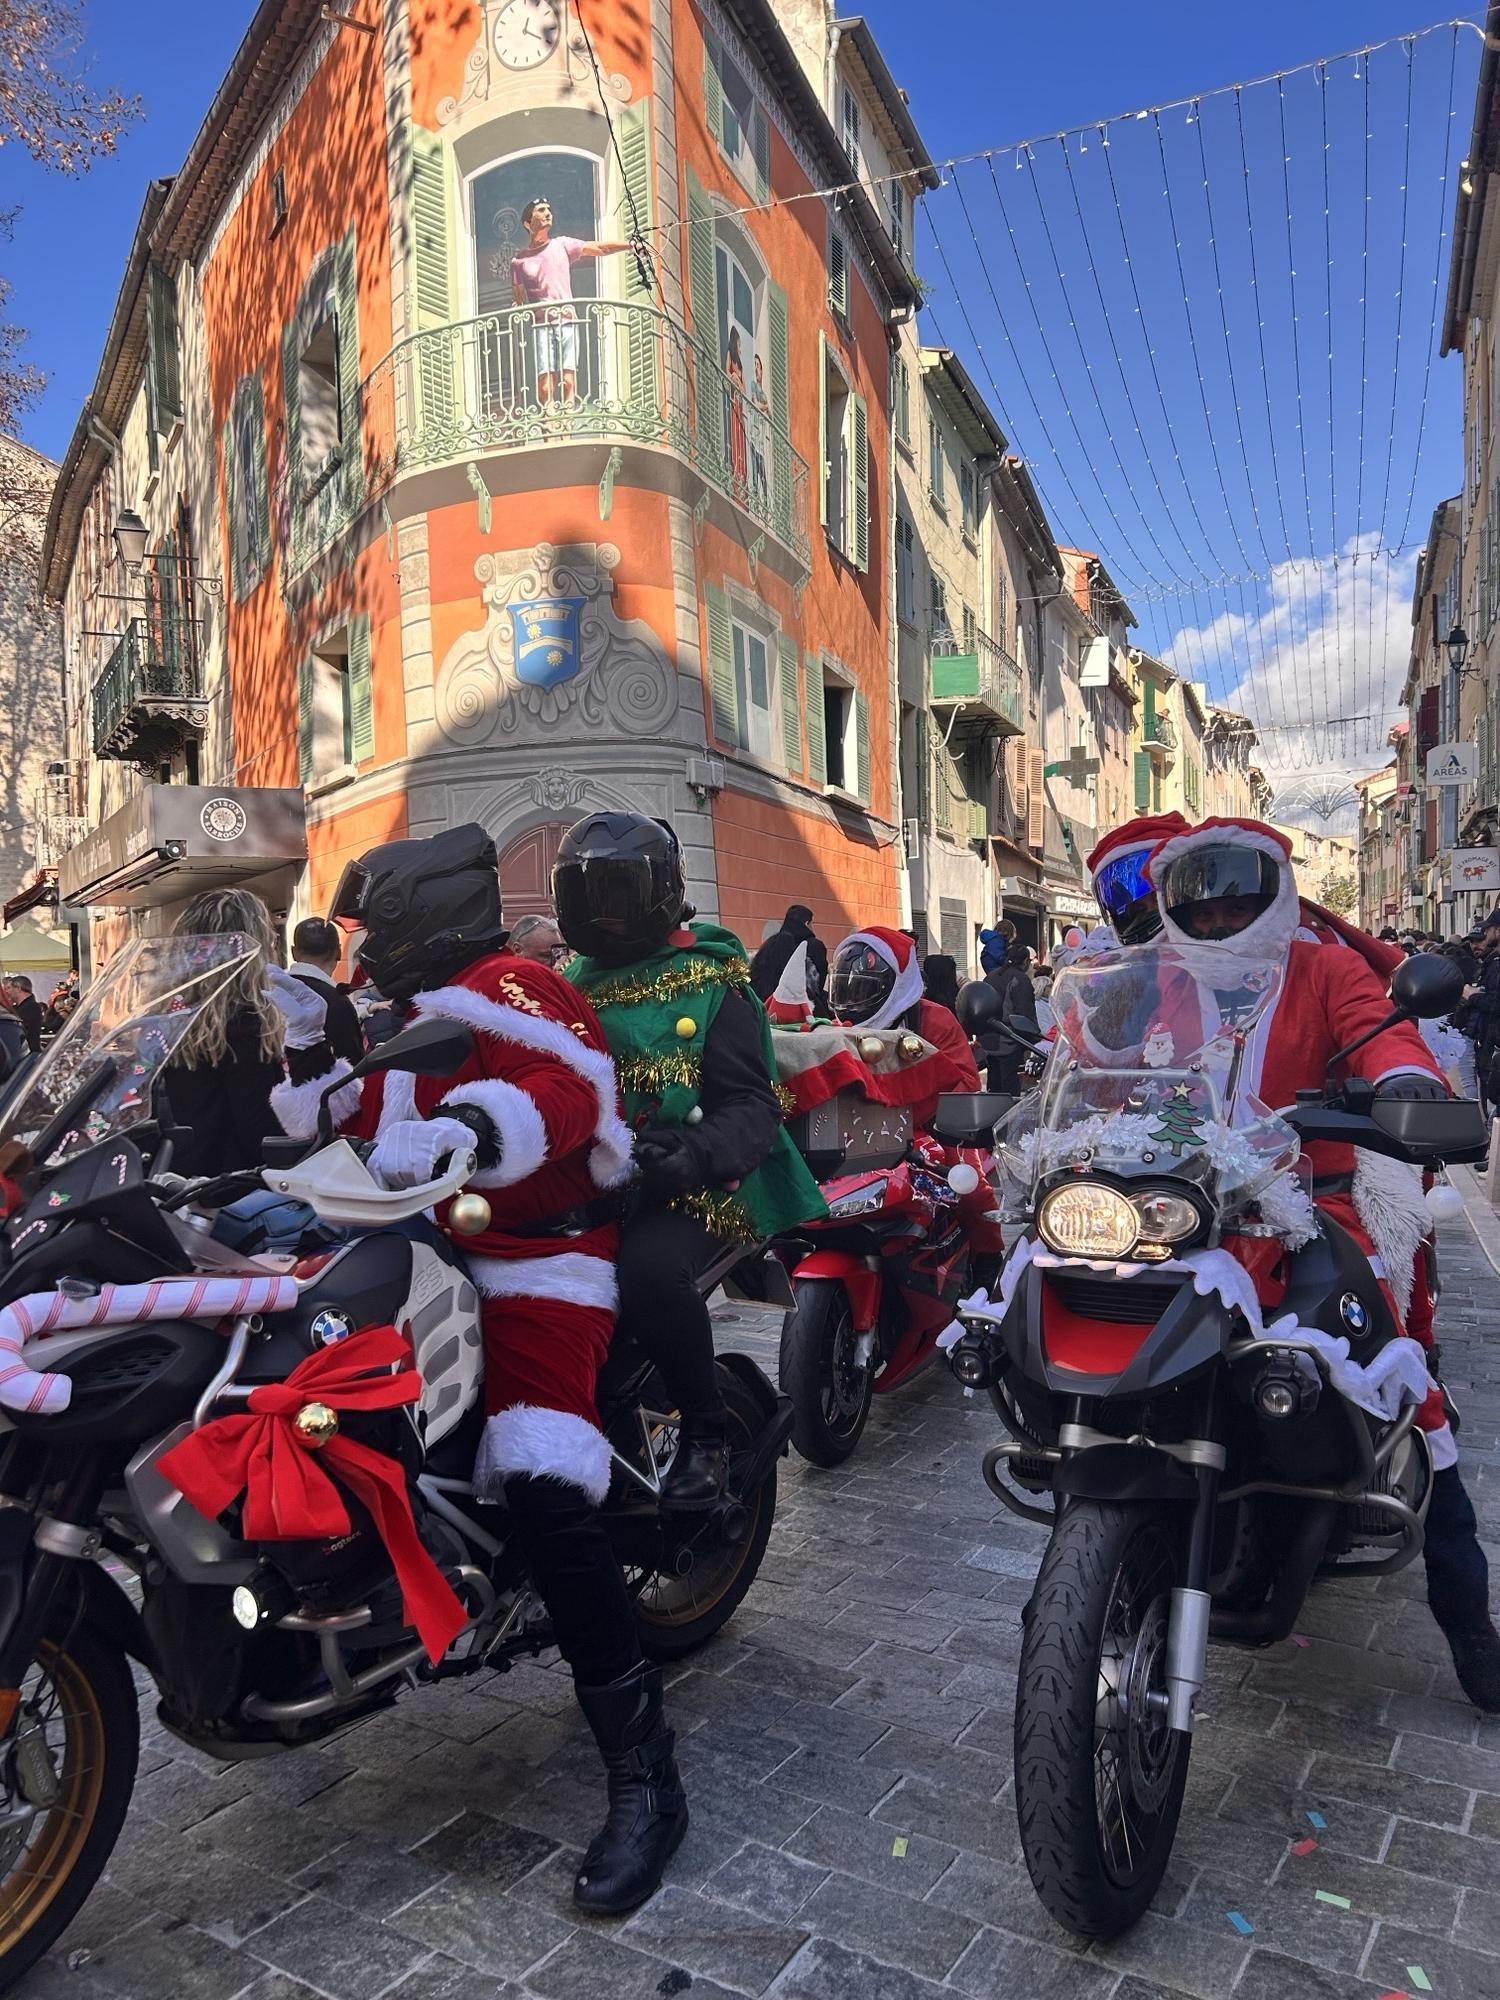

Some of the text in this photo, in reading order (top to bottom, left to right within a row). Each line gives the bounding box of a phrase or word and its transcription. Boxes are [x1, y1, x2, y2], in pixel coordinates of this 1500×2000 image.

[1433, 767, 1468, 776] AREAS
[206, 801, 240, 814] MAISON
[1461, 856, 1488, 864] FROMAGE
[314, 1311, 349, 1332] BMW
